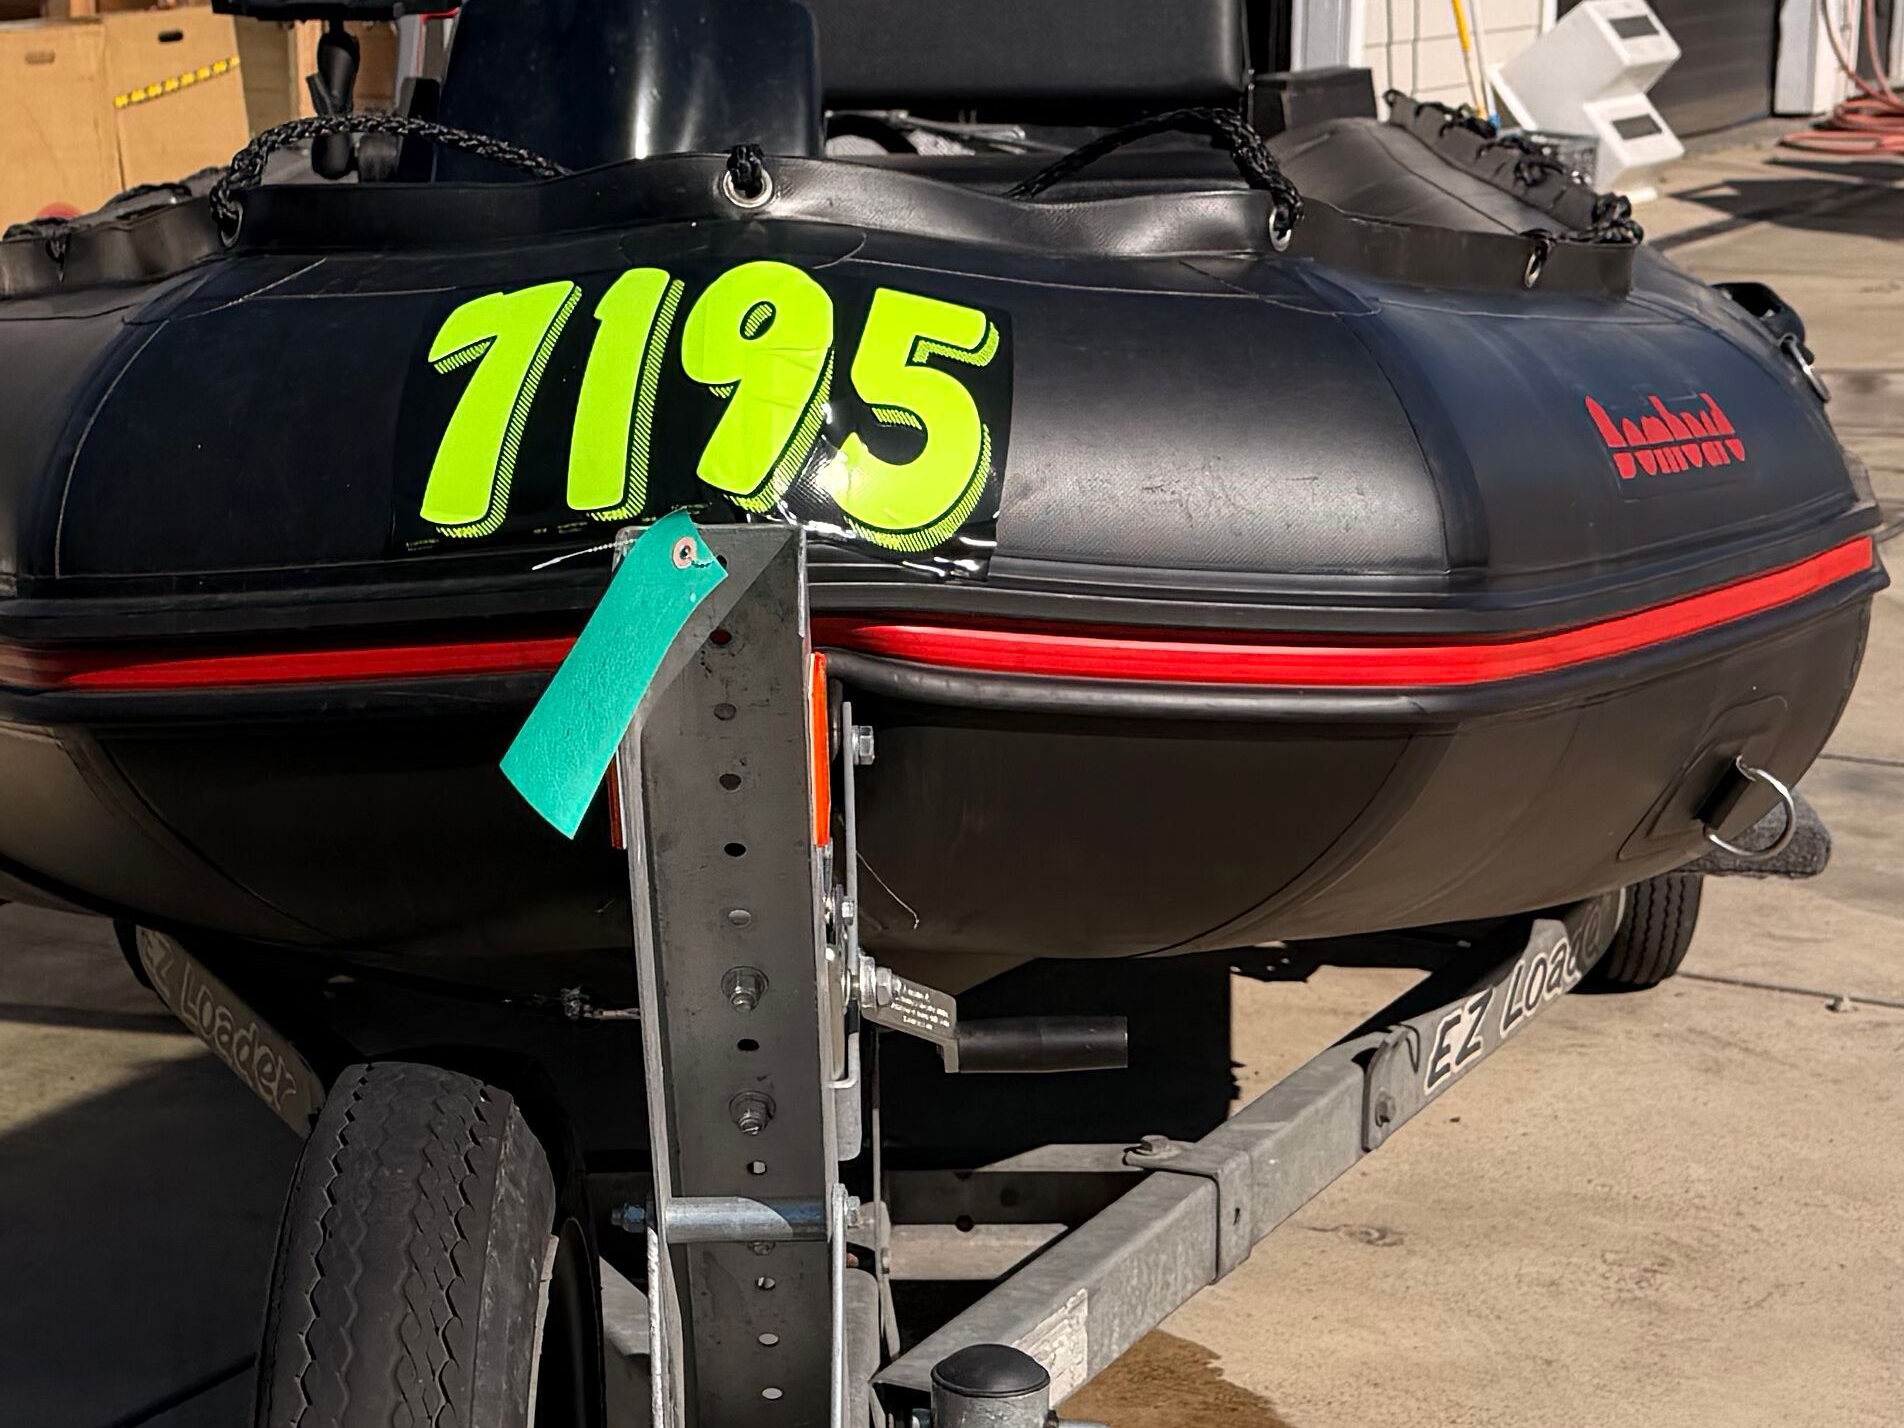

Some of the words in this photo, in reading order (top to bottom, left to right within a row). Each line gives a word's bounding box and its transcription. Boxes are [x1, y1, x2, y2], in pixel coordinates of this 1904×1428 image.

[420, 260, 1000, 553] 7195
[180, 956, 297, 1112] Loader
[1424, 986, 1495, 1096] EZ
